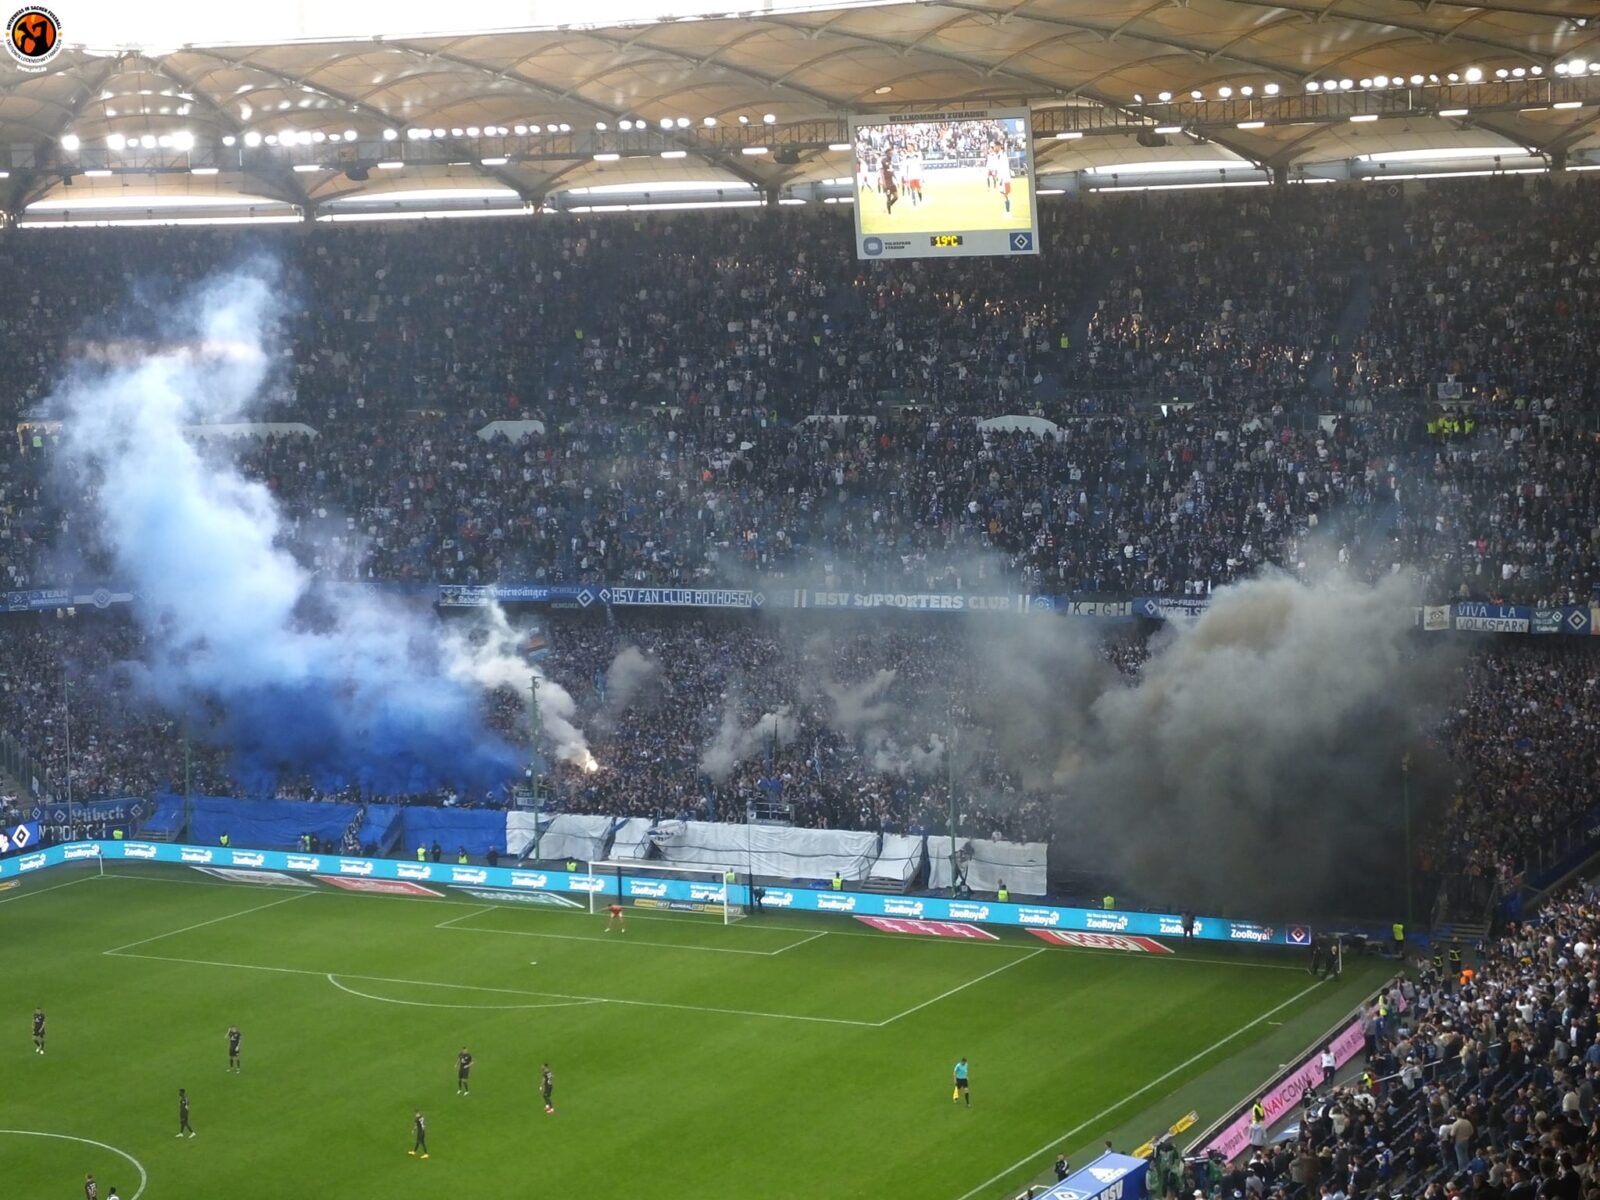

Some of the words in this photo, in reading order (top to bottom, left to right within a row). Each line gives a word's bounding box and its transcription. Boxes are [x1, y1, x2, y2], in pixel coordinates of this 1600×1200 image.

[889, 112, 945, 122] WILLKOMMEN
[935, 235, 958, 248] 19°C
[612, 590, 634, 602] HSV
[638, 591, 659, 603] FAN
[662, 591, 691, 604] CLUB
[695, 592, 752, 606] ROTHOSEN
[815, 592, 849, 606] HSV
[853, 593, 964, 609] SUPPORTERS
[968, 596, 1010, 610] CLUB
[1458, 604, 1487, 617] VIVA
[1499, 606, 1516, 618] LA
[1458, 618, 1525, 632] VOLKSPARK
[818, 899, 853, 912] ZooRoyal
[885, 903, 921, 917] ZooRoyal
[949, 908, 986, 921] ZooRoyal
[1019, 913, 1056, 926] ZooRoyal
[1087, 918, 1125, 931] ZooRoyal
[1231, 928, 1270, 943] ZooRoyal
